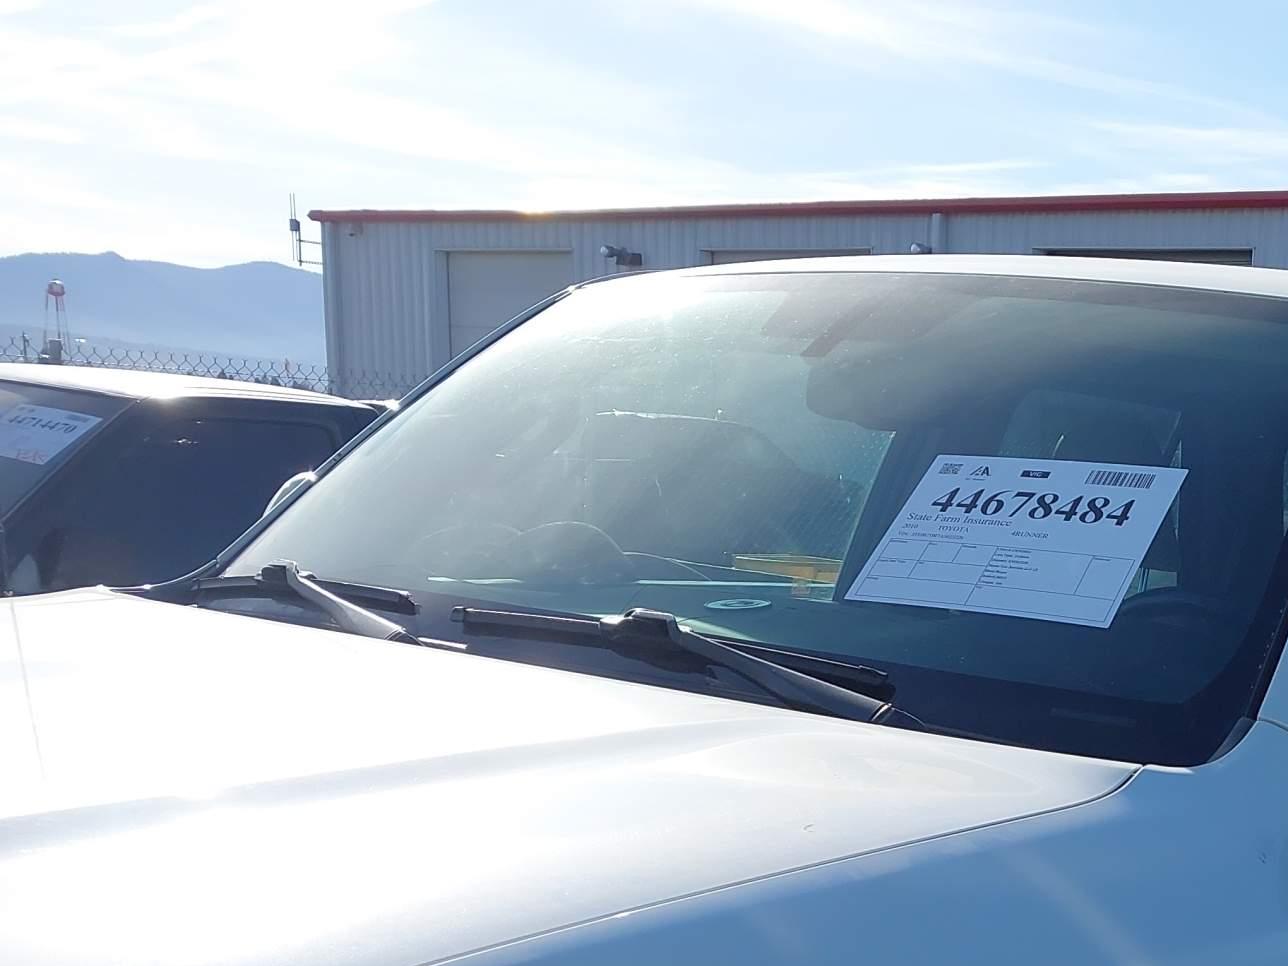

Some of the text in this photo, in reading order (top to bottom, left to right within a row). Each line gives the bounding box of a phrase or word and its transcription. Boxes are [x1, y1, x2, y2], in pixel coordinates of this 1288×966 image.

[931, 487, 1136, 526] 44678484
[907, 512, 1013, 527] State Farm Insurance
[938, 525, 970, 533] TOYOTA
[1011, 530, 1049, 539] 4RUNNER
